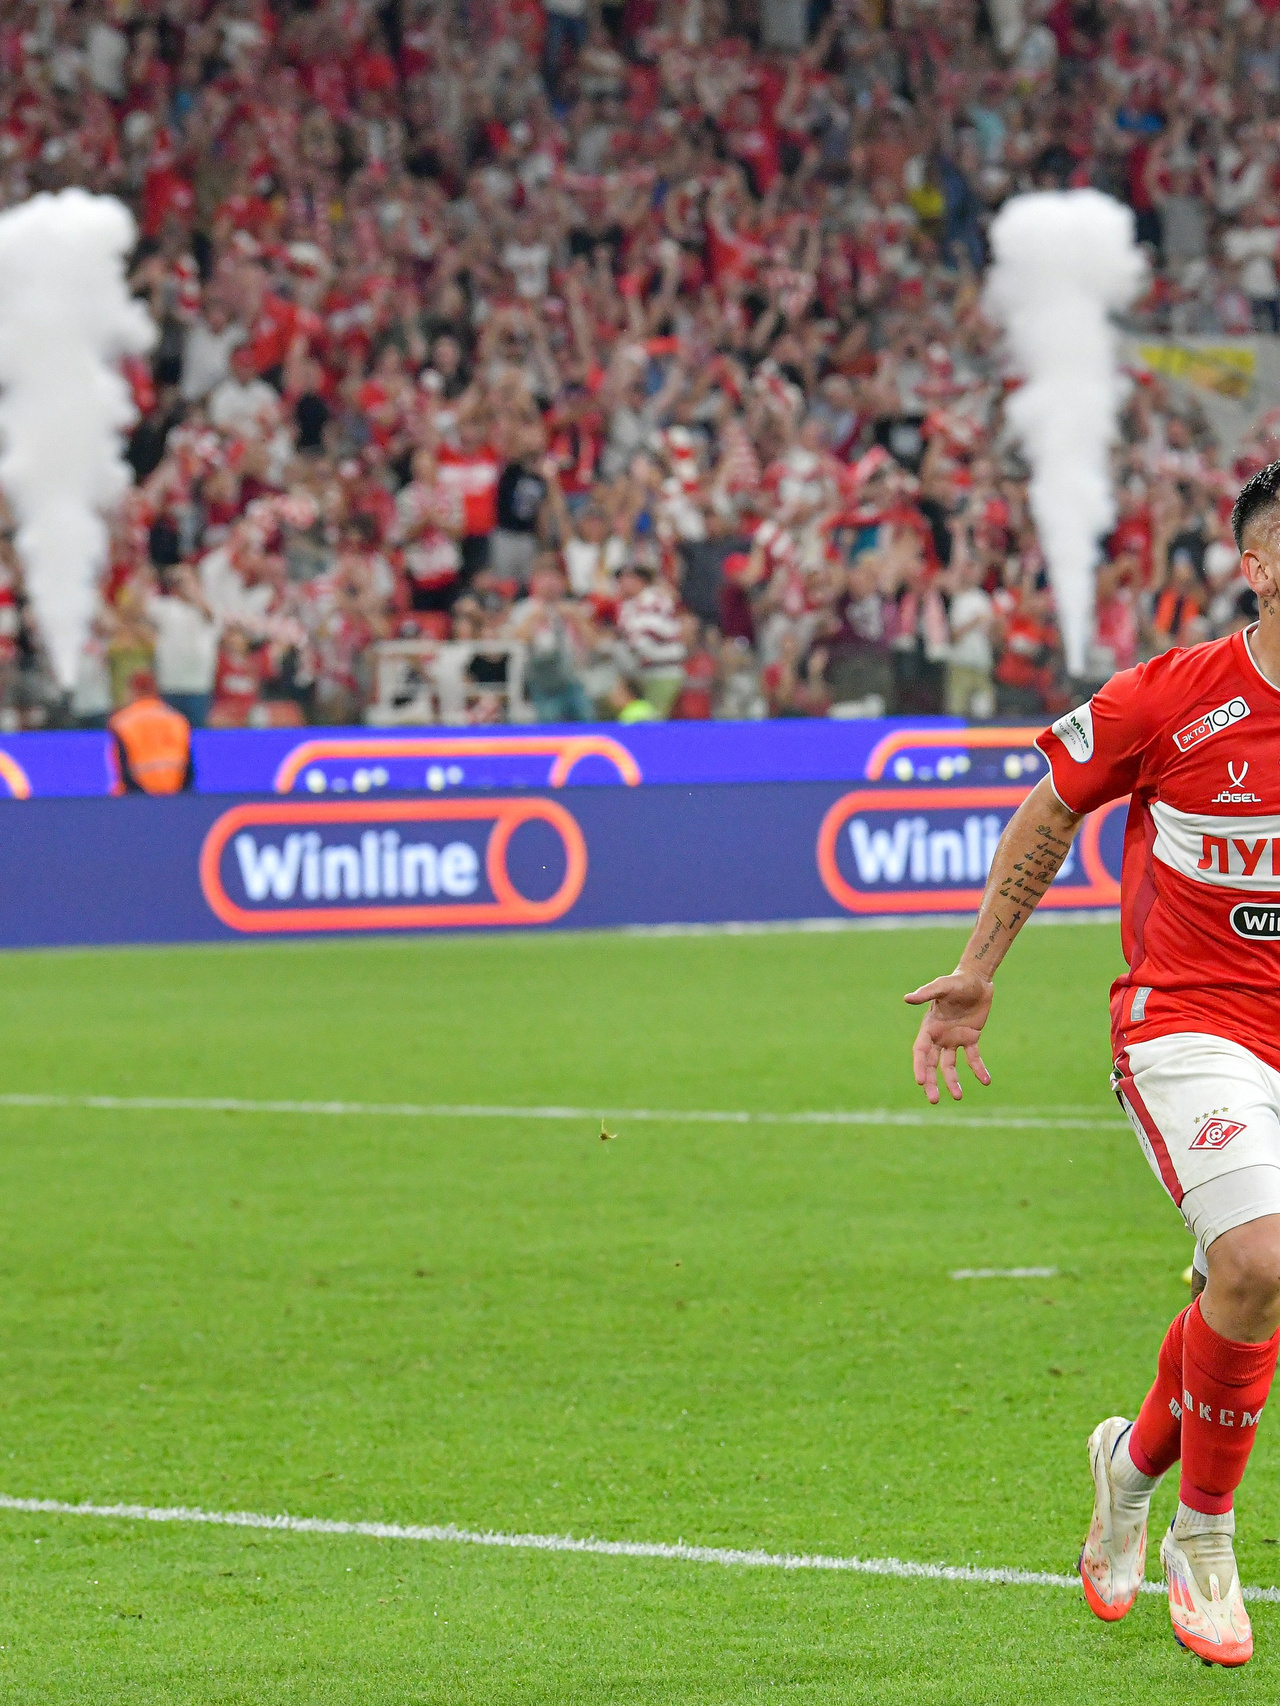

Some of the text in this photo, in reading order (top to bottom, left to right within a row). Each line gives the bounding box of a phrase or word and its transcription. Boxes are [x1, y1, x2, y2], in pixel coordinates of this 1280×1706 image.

[1181, 700, 1246, 745] ЭКТО 100
[1211, 790, 1262, 803] JÖGEL
[235, 829, 478, 901] Winline
